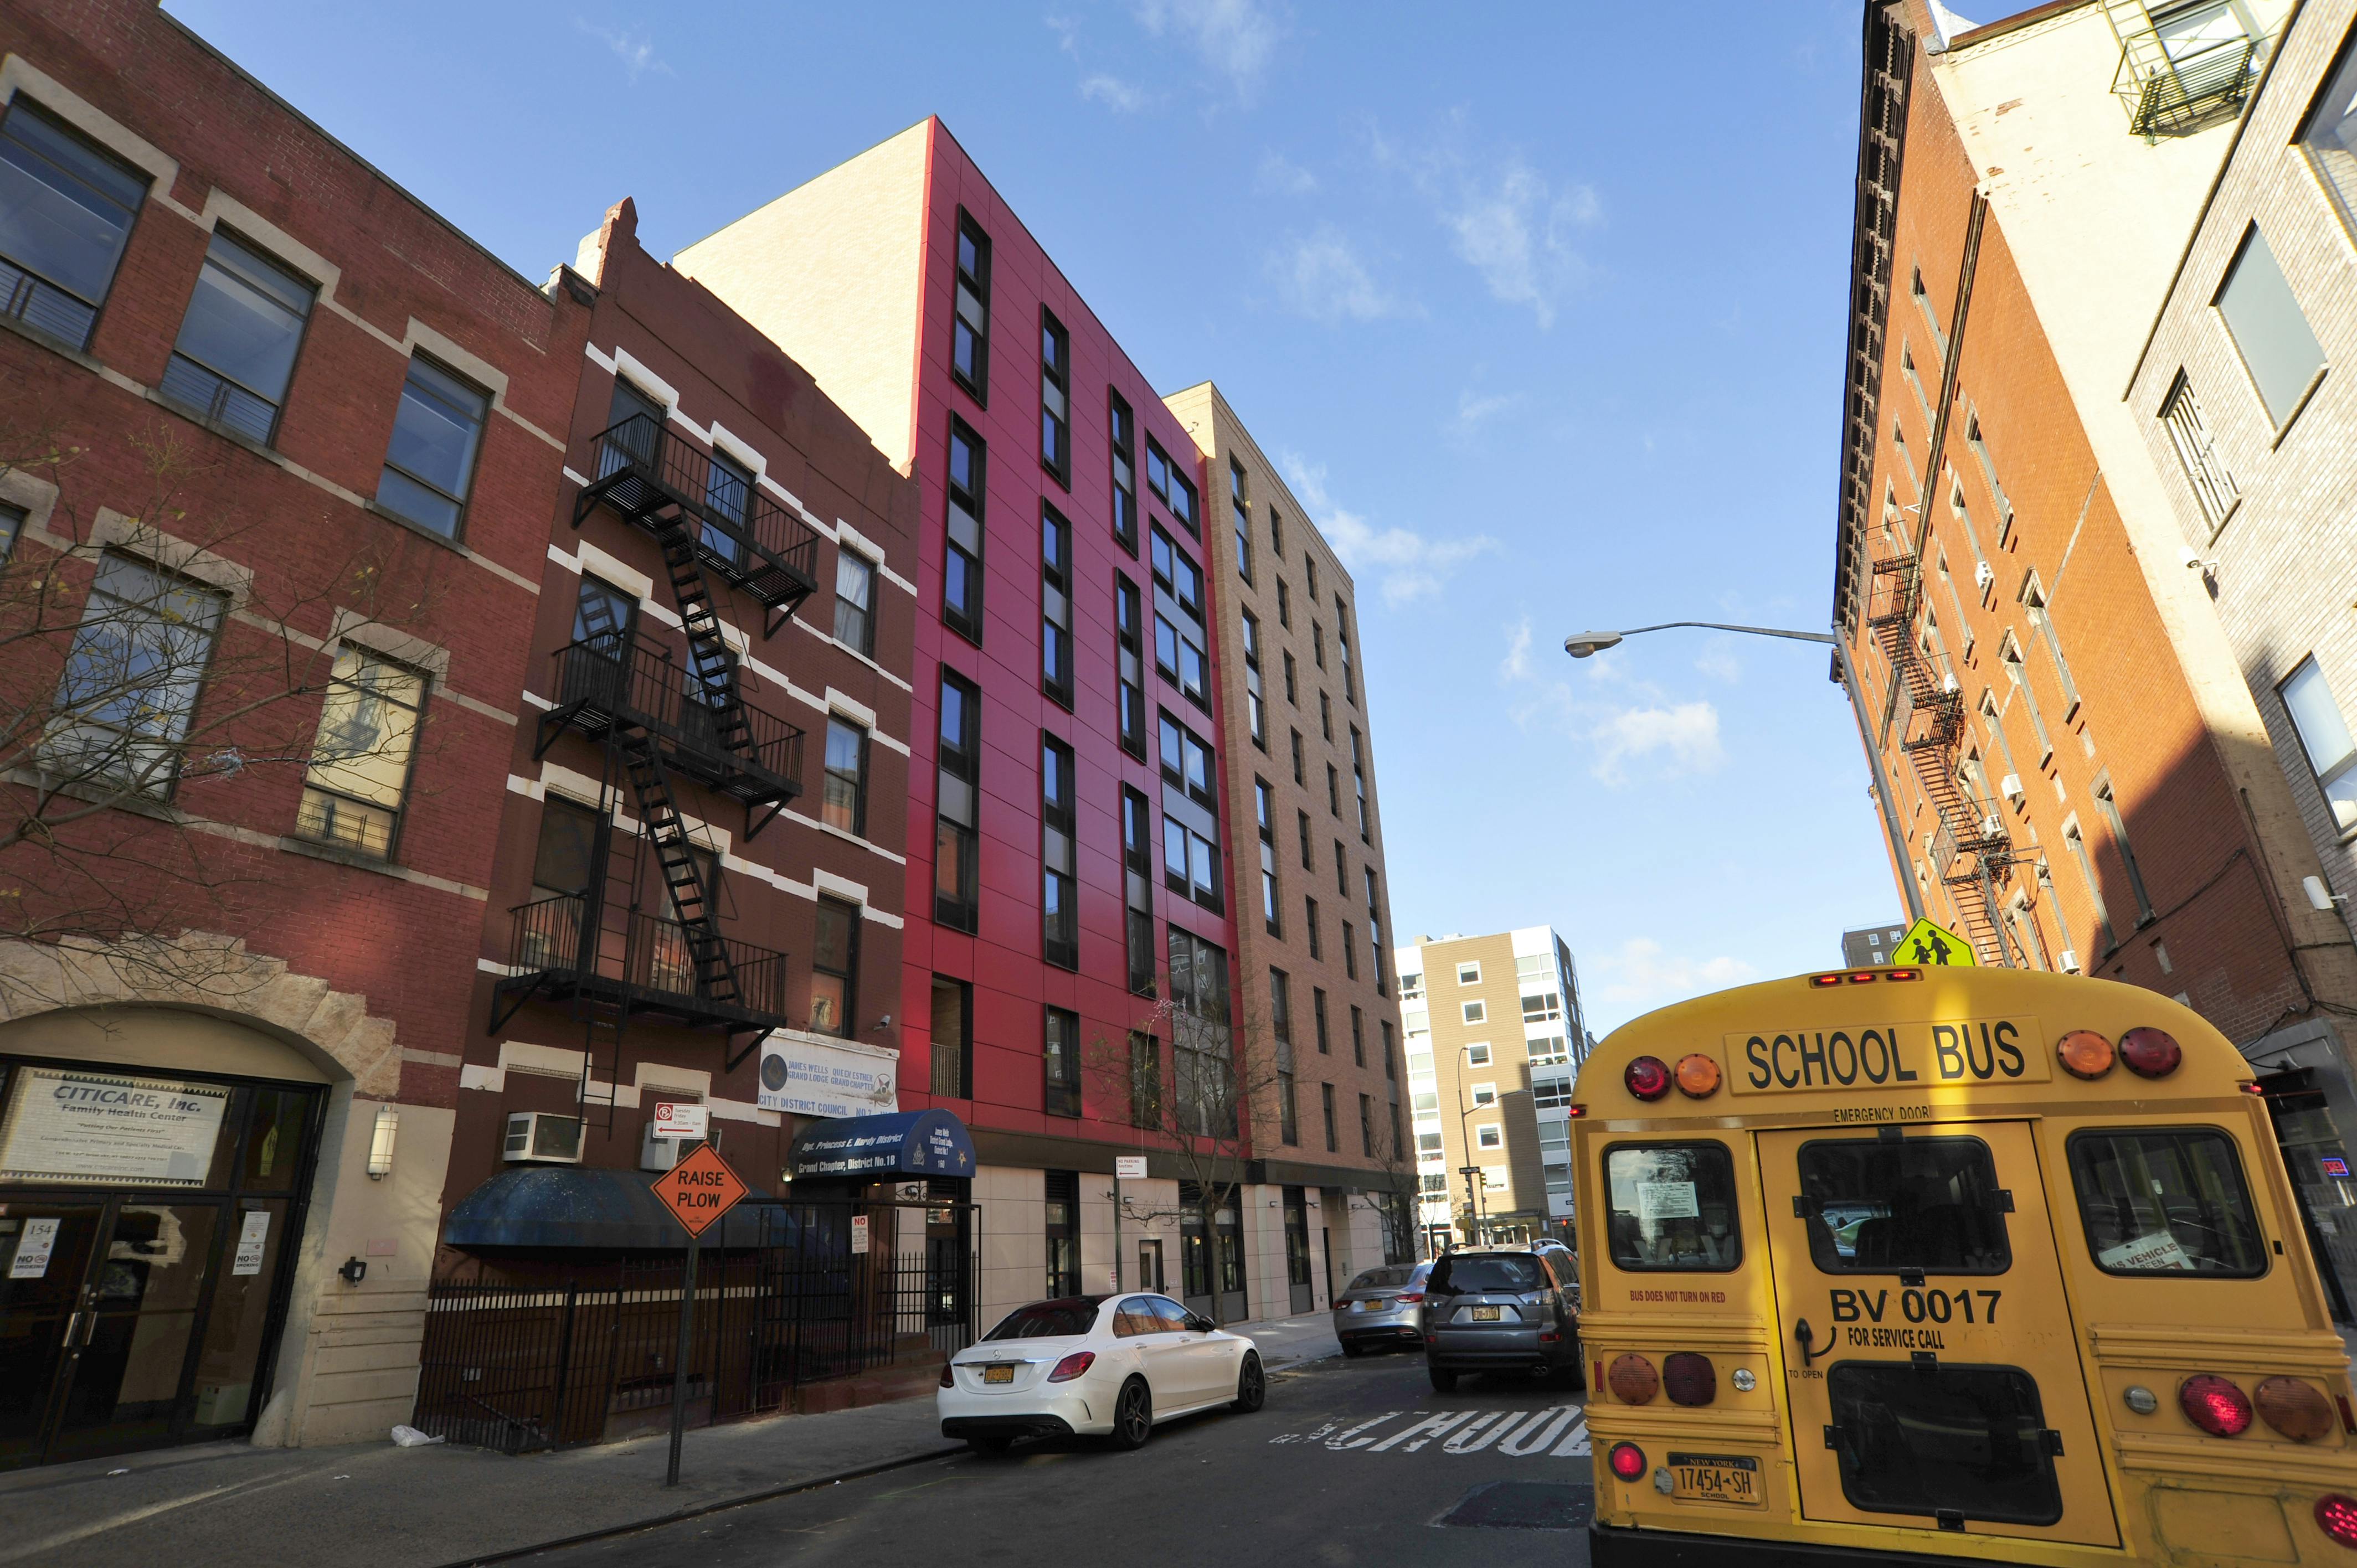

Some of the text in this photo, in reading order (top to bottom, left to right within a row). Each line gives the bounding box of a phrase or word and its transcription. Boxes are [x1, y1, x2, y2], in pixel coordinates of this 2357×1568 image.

[1746, 1021, 2025, 1089] SCHOOL BUS
[788, 1060, 828, 1074] JAMES WELLS
[832, 1068, 873, 1082] QUEEN ESTHER
[788, 1071, 828, 1084] GRAND LODGE
[831, 1077, 874, 1091] GRAND CHAPTER
[53, 1085, 201, 1112] CITICARE, Inc.
[759, 1095, 778, 1107] CITY
[781, 1098, 815, 1111] DISTRICT
[818, 1102, 847, 1116] COUNCIL
[62, 1103, 187, 1122] Family Health Center
[1834, 1106, 1931, 1123] EMERGENCY DOOR
[816, 1139, 846, 1150] Princess
[846, 1139, 853, 1148] E.
[854, 1136, 876, 1147] Hardy
[876, 1133, 903, 1144] District
[799, 1162, 817, 1173] Grand
[819, 1160, 846, 1173] Chapter,
[847, 1157, 873, 1169] District
[678, 1170, 724, 1186] RAISE
[677, 1192, 720, 1208] PLOW
[30, 1225, 51, 1235] 154
[2126, 1242, 2178, 1266] VEHICLE
[2139, 1258, 2165, 1268] BEEN
[1630, 1290, 1726, 1303] BUS DOES NOT TURN ON RED
[1830, 1290, 2001, 1324] BV 0017
[1847, 1327, 1945, 1349] FOR SERVICE CALL
[1788, 1370, 1823, 1379] TO OPEN
